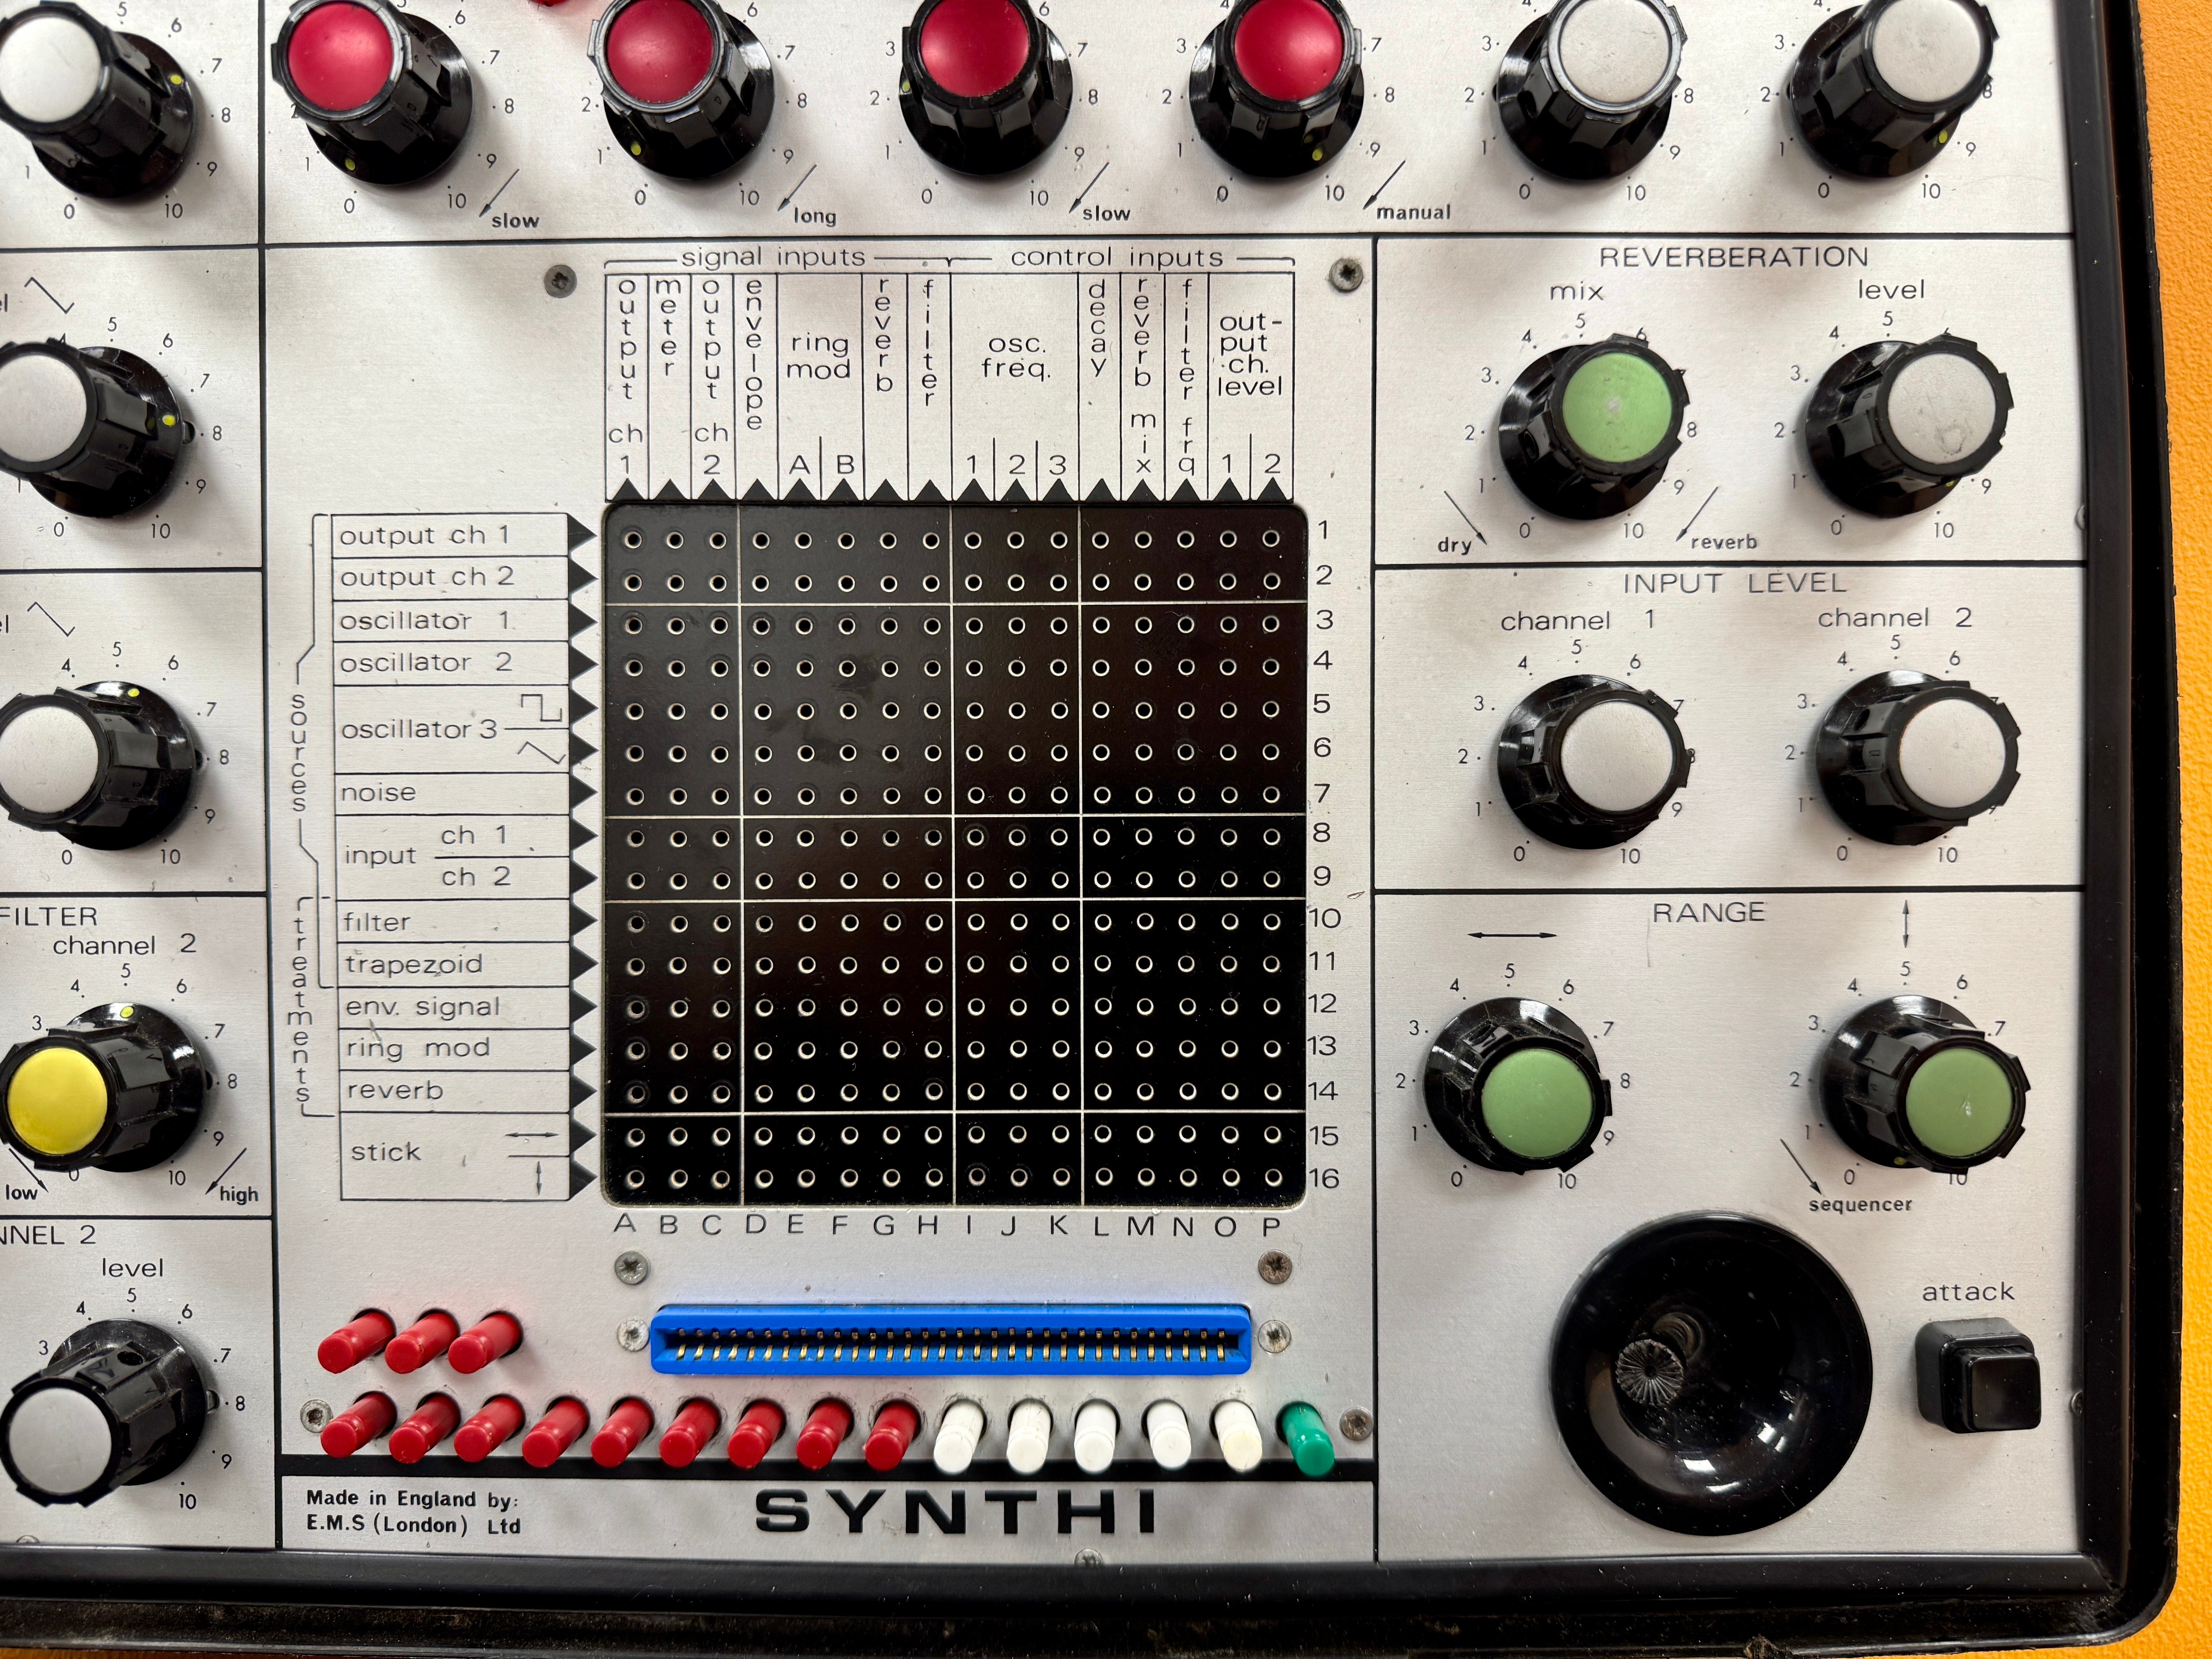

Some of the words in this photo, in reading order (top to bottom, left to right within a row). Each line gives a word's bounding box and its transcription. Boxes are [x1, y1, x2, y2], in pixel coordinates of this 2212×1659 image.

[455, 10, 465, 24] 6
[785, 45, 795, 60] 7
[1177, 38, 1186, 53] 3
[1465, 87, 1474, 102] 2
[222, 107, 230, 123] 8
[1030, 190, 1048, 206] 10
[165, 203, 183, 218] 10
[795, 207, 836, 227] long
[1084, 205, 1130, 221] slow
[1377, 204, 1450, 220] manual
[492, 213, 539, 228] slow
[682, 246, 761, 271] signal
[778, 246, 865, 270] inputs
[1012, 246, 1111, 266] control
[1131, 246, 1223, 271] inputs
[1601, 246, 1867, 267] REVERBERATION
[1551, 281, 1603, 300] mix
[1860, 279, 1924, 299] level
[656, 280, 681, 376] meter
[1089, 279, 1106, 377] decay
[1220, 313, 1282, 331] out-
[619, 280, 636, 399] output
[703, 280, 721, 399] output
[875, 279, 893, 392] reverb
[1134, 279, 1151, 386] reverb
[1180, 279, 1194, 400] filter
[793, 333, 848, 357] ring
[922, 280, 937, 406] filter
[989, 338, 1045, 352] osc.
[1221, 335, 1267, 356] put
[746, 280, 763, 430] envelope
[1229, 354, 1268, 373] ch.
[787, 359, 850, 380] mod
[982, 358, 1050, 382] freq.
[1482, 367, 1491, 383] 3
[1219, 376, 1281, 396] level
[213, 426, 222, 441] 8
[609, 424, 642, 443] ch
[695, 422, 728, 441] ch
[1132, 414, 1156, 473] mix
[1179, 417, 1194, 476] frq
[621, 455, 629, 474] 1
[704, 455, 720, 474] 2
[789, 455, 810, 474] A
[837, 455, 854, 474] B
[967, 455, 975, 474] 1
[1010, 455, 1025, 474] 2
[1049, 455, 1066, 475] 3
[1223, 454, 1230, 473] 1
[1265, 454, 1280, 473] 2
[1674, 479, 1684, 495] 9
[152, 523, 170, 538] 10
[340, 527, 434, 549] output
[449, 525, 485, 544] ch
[500, 525, 507, 543] 1
[1319, 520, 1327, 539] 1
[1934, 523, 1954, 538] 10
[1438, 537, 1471, 555] dry
[1692, 534, 1757, 549] reverb
[341, 569, 435, 590] output
[452, 567, 485, 586] ch
[498, 566, 514, 585] 2
[1317, 565, 1332, 585] 2
[1625, 574, 1723, 593] INPUT
[1749, 572, 1846, 593] LEVEL
[340, 611, 472, 630] oscillator
[500, 611, 507, 629] 1
[1317, 610, 1333, 629] 3
[1501, 611, 1609, 631] channel
[1646, 610, 1652, 628] 1
[1819, 608, 1928, 627] channel
[1956, 608, 1972, 627] 2
[168, 655, 179, 670] 6
[341, 653, 471, 672] oscillator
[496, 652, 512, 671] 2
[1314, 651, 1333, 670] 4
[1950, 651, 1960, 666] 6
[1314, 694, 1330, 713] 5
[342, 720, 472, 738] oscillator
[480, 719, 496, 739] 3
[291, 695, 307, 811] sources
[1314, 737, 1331, 757] 6
[342, 782, 416, 802] noise
[1314, 783, 1330, 803] 7
[441, 825, 474, 844] ch
[496, 825, 505, 843] 1
[1313, 823, 1330, 842] 8
[161, 849, 180, 864] 10
[347, 845, 416, 869] input
[1621, 848, 1640, 864] 10
[1938, 847, 1958, 863] 10
[443, 867, 475, 886] ch
[495, 866, 510, 886] 2
[1314, 866, 1331, 886] 9
[343, 912, 410, 931] filter
[1309, 908, 1341, 928] 10
[1654, 902, 1765, 922] RANGE
[53, 935, 155, 955] channel
[181, 933, 196, 953] 2
[345, 954, 482, 978] trapezoid
[1309, 951, 1334, 970] 11
[288, 918, 312, 1102] treatments
[346, 1001, 398, 1015] env.
[416, 996, 499, 1021] signal
[1309, 993, 1336, 1013] 12
[348, 1037, 402, 1063] ring
[426, 1037, 489, 1057] mod
[1307, 1036, 1336, 1056] 13
[349, 1080, 443, 1099] reverb
[1308, 1081, 1338, 1100] 14
[1310, 1126, 1338, 1146] 15
[352, 1142, 421, 1161] stick
[168, 1170, 185, 1185] 10
[1309, 1168, 1339, 1188] 16
[1558, 1173, 1576, 1189] 10
[1844, 1169, 1855, 1185] 0
[6, 1184, 38, 1200] low
[220, 1186, 258, 1205] high
[1810, 1200, 1912, 1214] sequencer
[81, 1225, 96, 1244] 2
[613, 1213, 636, 1232] A
[660, 1215, 678, 1234] B
[702, 1215, 721, 1235] C
[746, 1214, 766, 1233] D
[788, 1214, 803, 1233] E
[833, 1216, 847, 1235] F
[874, 1215, 894, 1235] G
[919, 1215, 937, 1234] H
[968, 1215, 970, 1234] I
[1001, 1216, 1015, 1236] J
[1051, 1215, 1068, 1235] K
[1095, 1217, 1109, 1236] L
[1128, 1216, 1154, 1235] M
[1173, 1217, 1193, 1236] N
[1215, 1216, 1236, 1237] O
[1263, 1218, 1280, 1237] P
[103, 1258, 163, 1277] level
[1923, 1281, 2014, 1301] attack
[182, 1304, 192, 1319] 6
[179, 1494, 196, 1509] 10
[307, 1489, 358, 1504] Made
[370, 1490, 386, 1505] in
[398, 1491, 476, 1509] England
[489, 1492, 517, 1512] by:
[756, 1489, 1154, 1535] SYNTHI
[307, 1514, 364, 1531] E.M.S
[374, 1513, 467, 1537] (London)
[488, 1518, 520, 1534] Ltd
